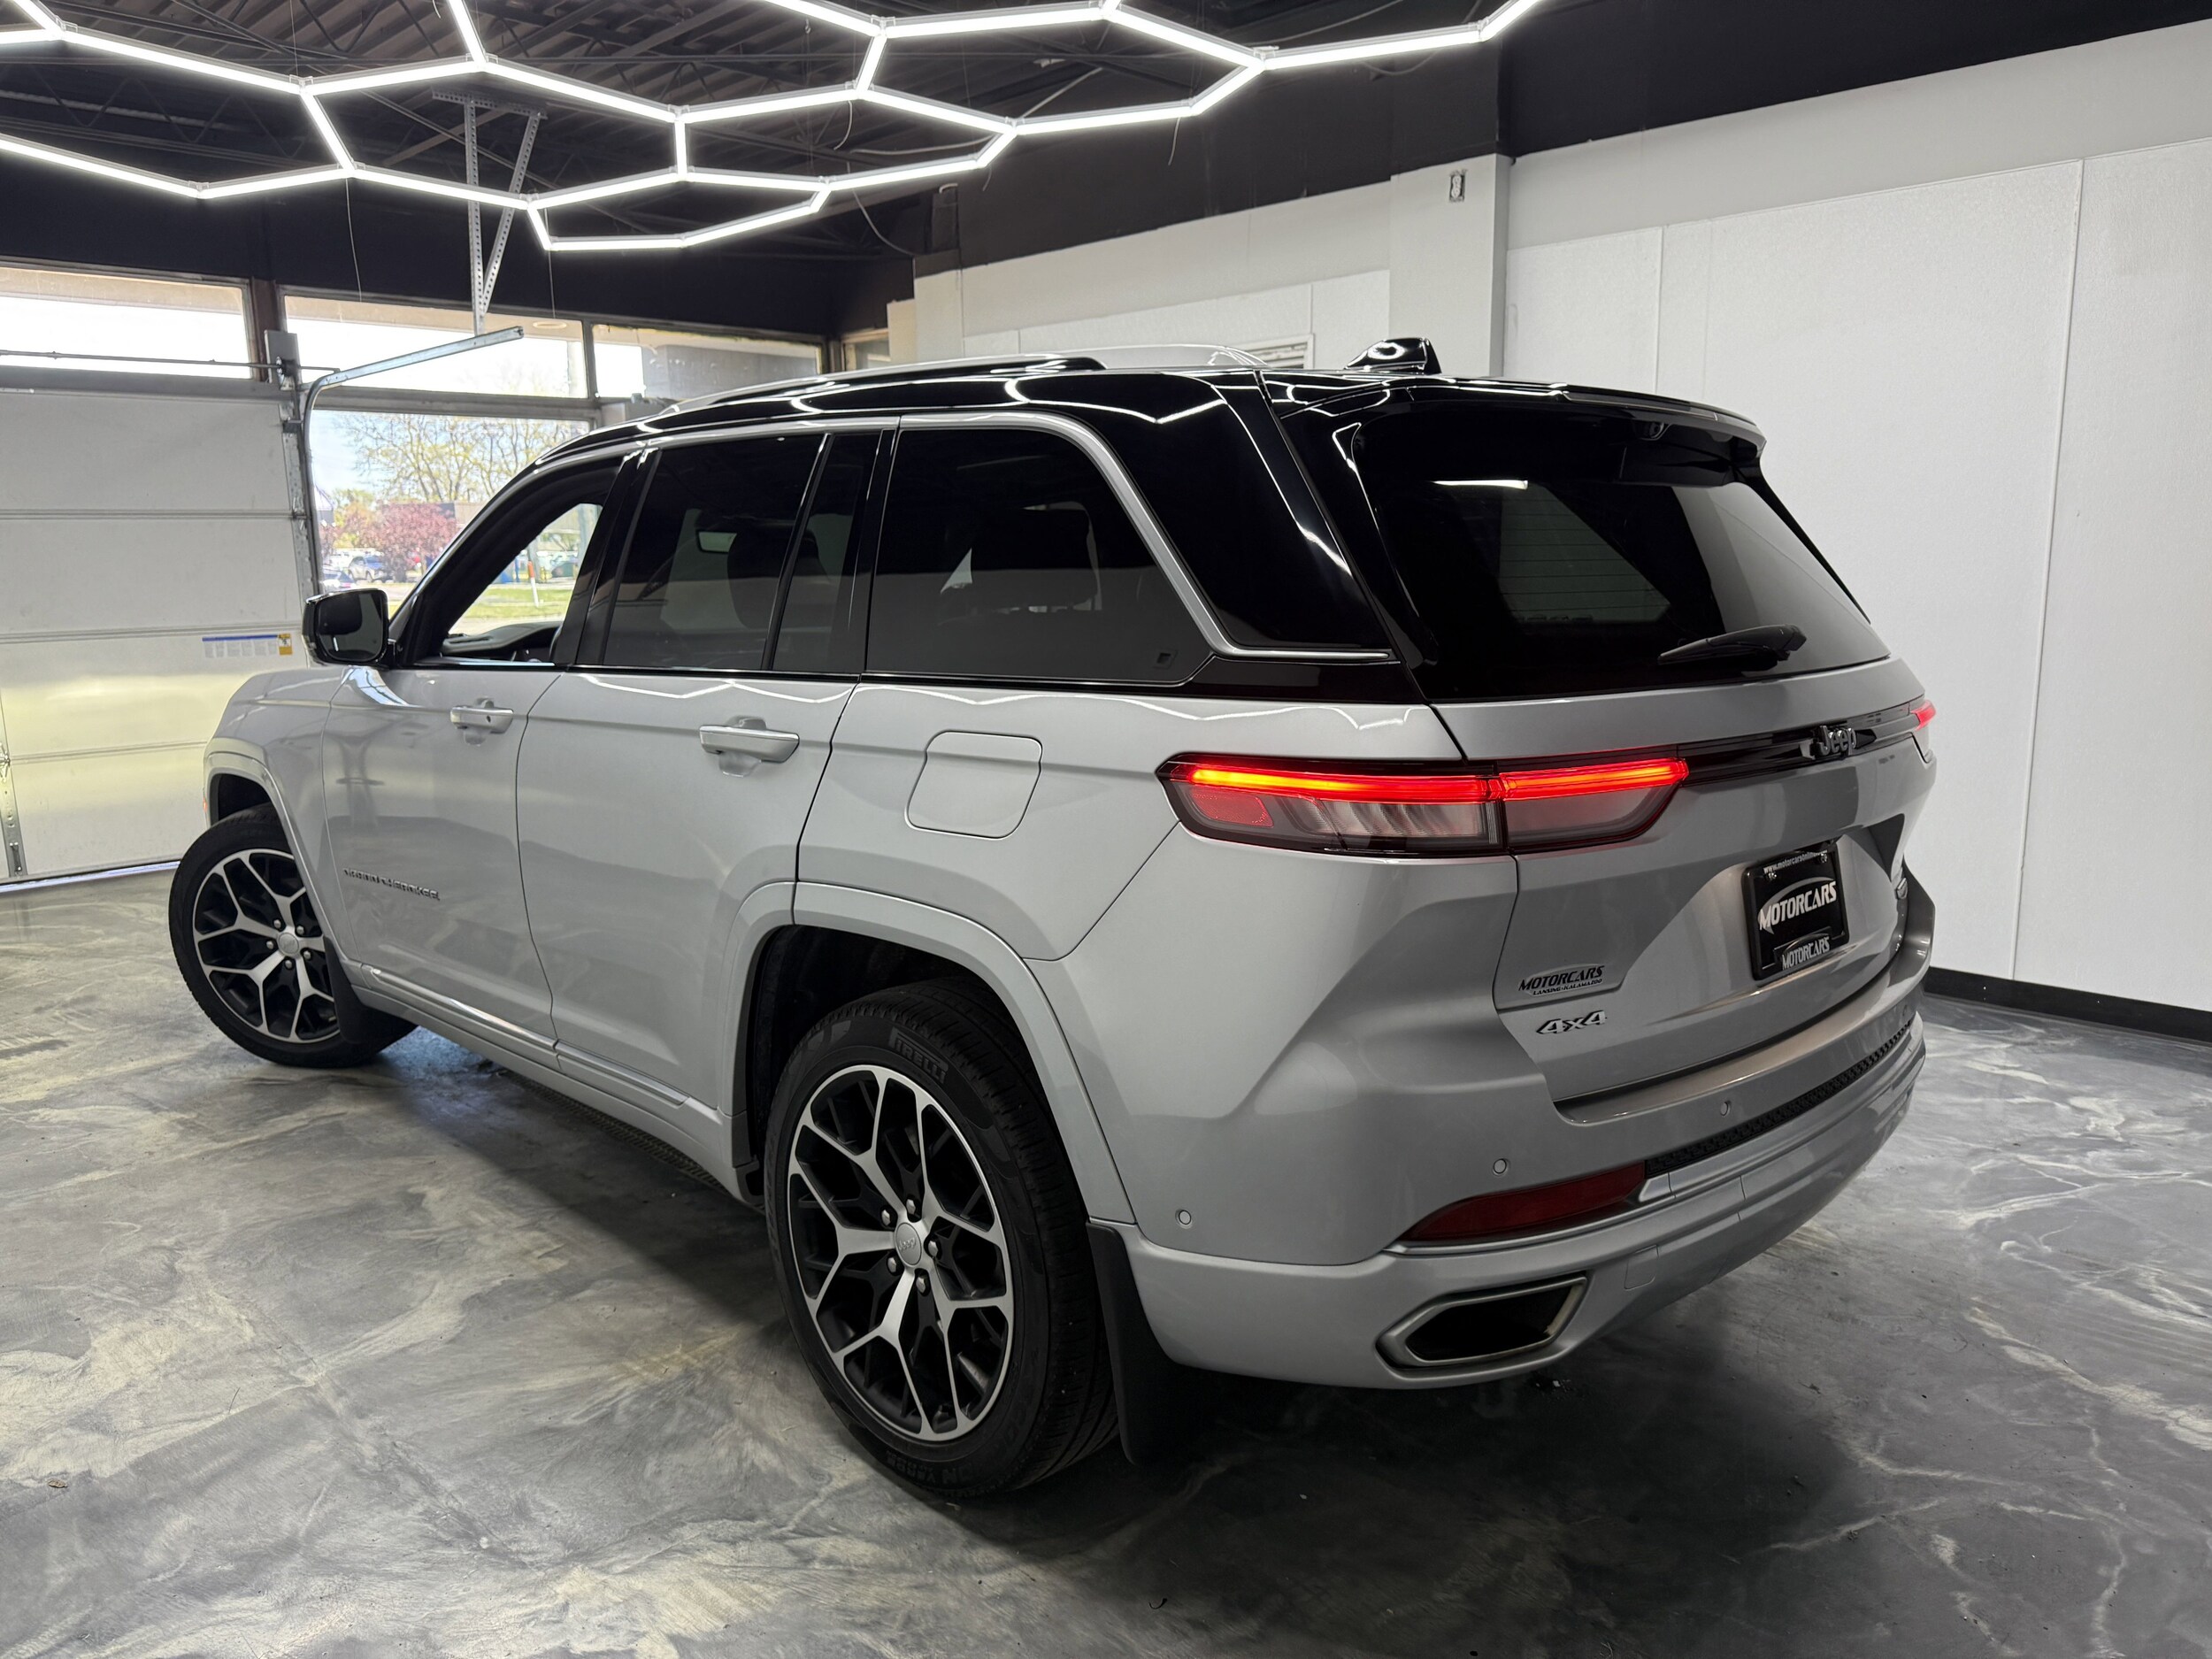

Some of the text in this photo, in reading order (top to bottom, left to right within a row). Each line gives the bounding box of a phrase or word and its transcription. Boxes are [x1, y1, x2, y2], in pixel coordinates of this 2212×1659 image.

[1819, 726, 1857, 756] Jeep
[1759, 881, 1838, 931] MOTORCARS
[1781, 935, 1830, 971] MOTORCARS
[1518, 965, 1605, 991] MOTORCARS
[1532, 979, 1602, 995] LANSING KALAMAZOO
[1536, 1010, 1607, 1034] 4x4
[888, 1026, 949, 1084] PIRELLI
[898, 1238, 917, 1251] Jeep
